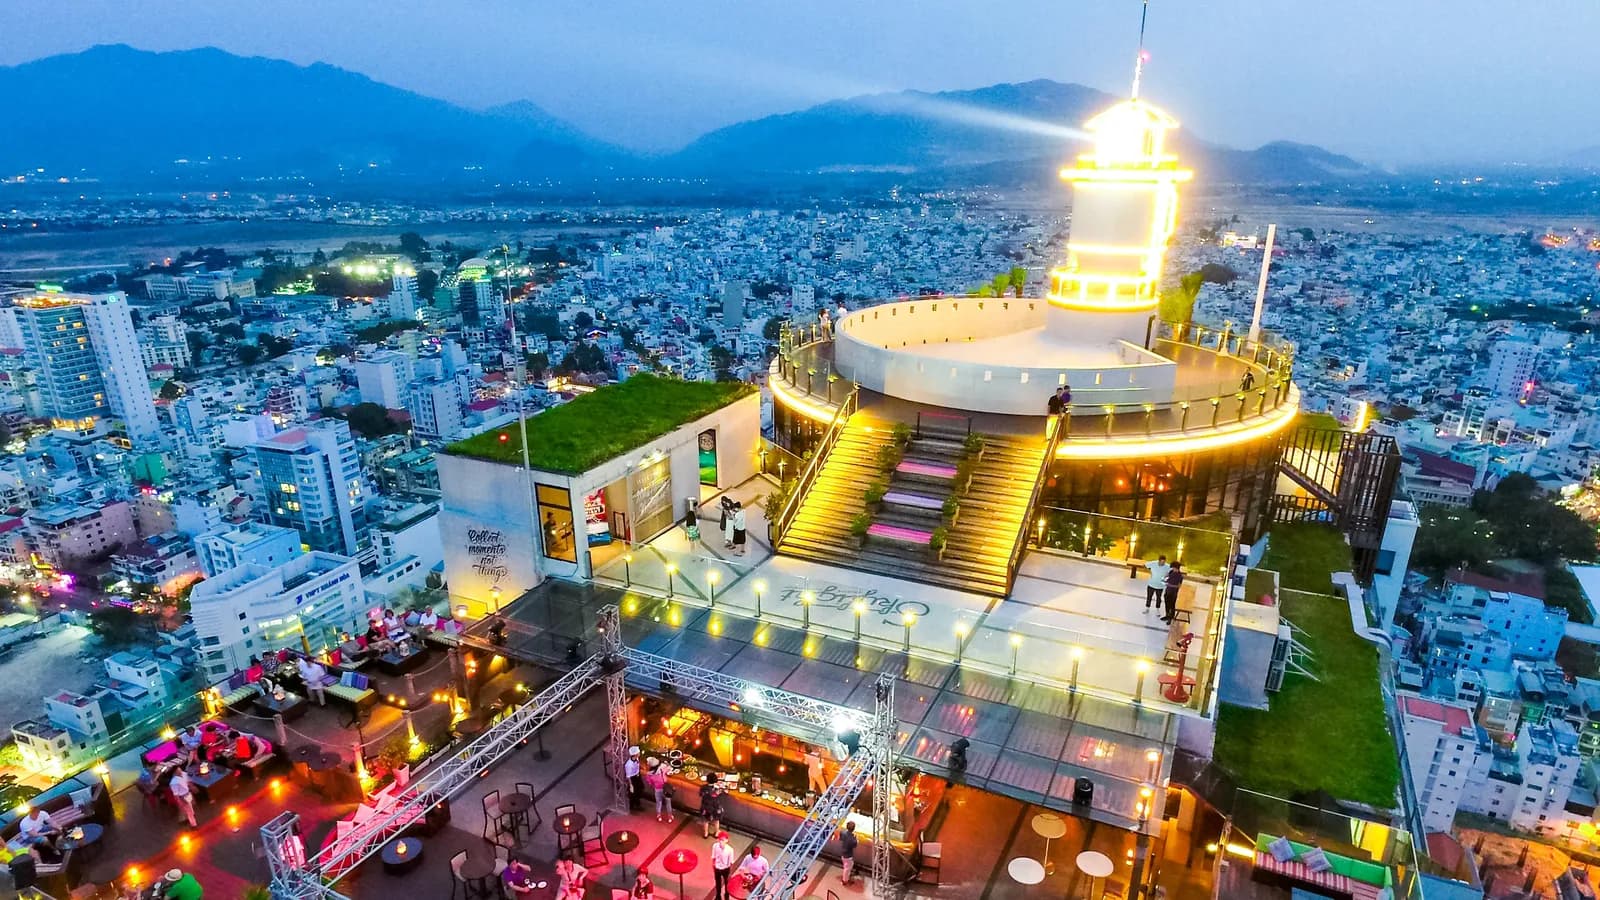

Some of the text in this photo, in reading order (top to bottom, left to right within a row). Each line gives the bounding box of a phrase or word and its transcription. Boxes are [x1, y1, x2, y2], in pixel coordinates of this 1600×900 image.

[468, 529, 501, 544] Collect
[468, 543, 506, 555] moments
[480, 554, 498, 565] not
